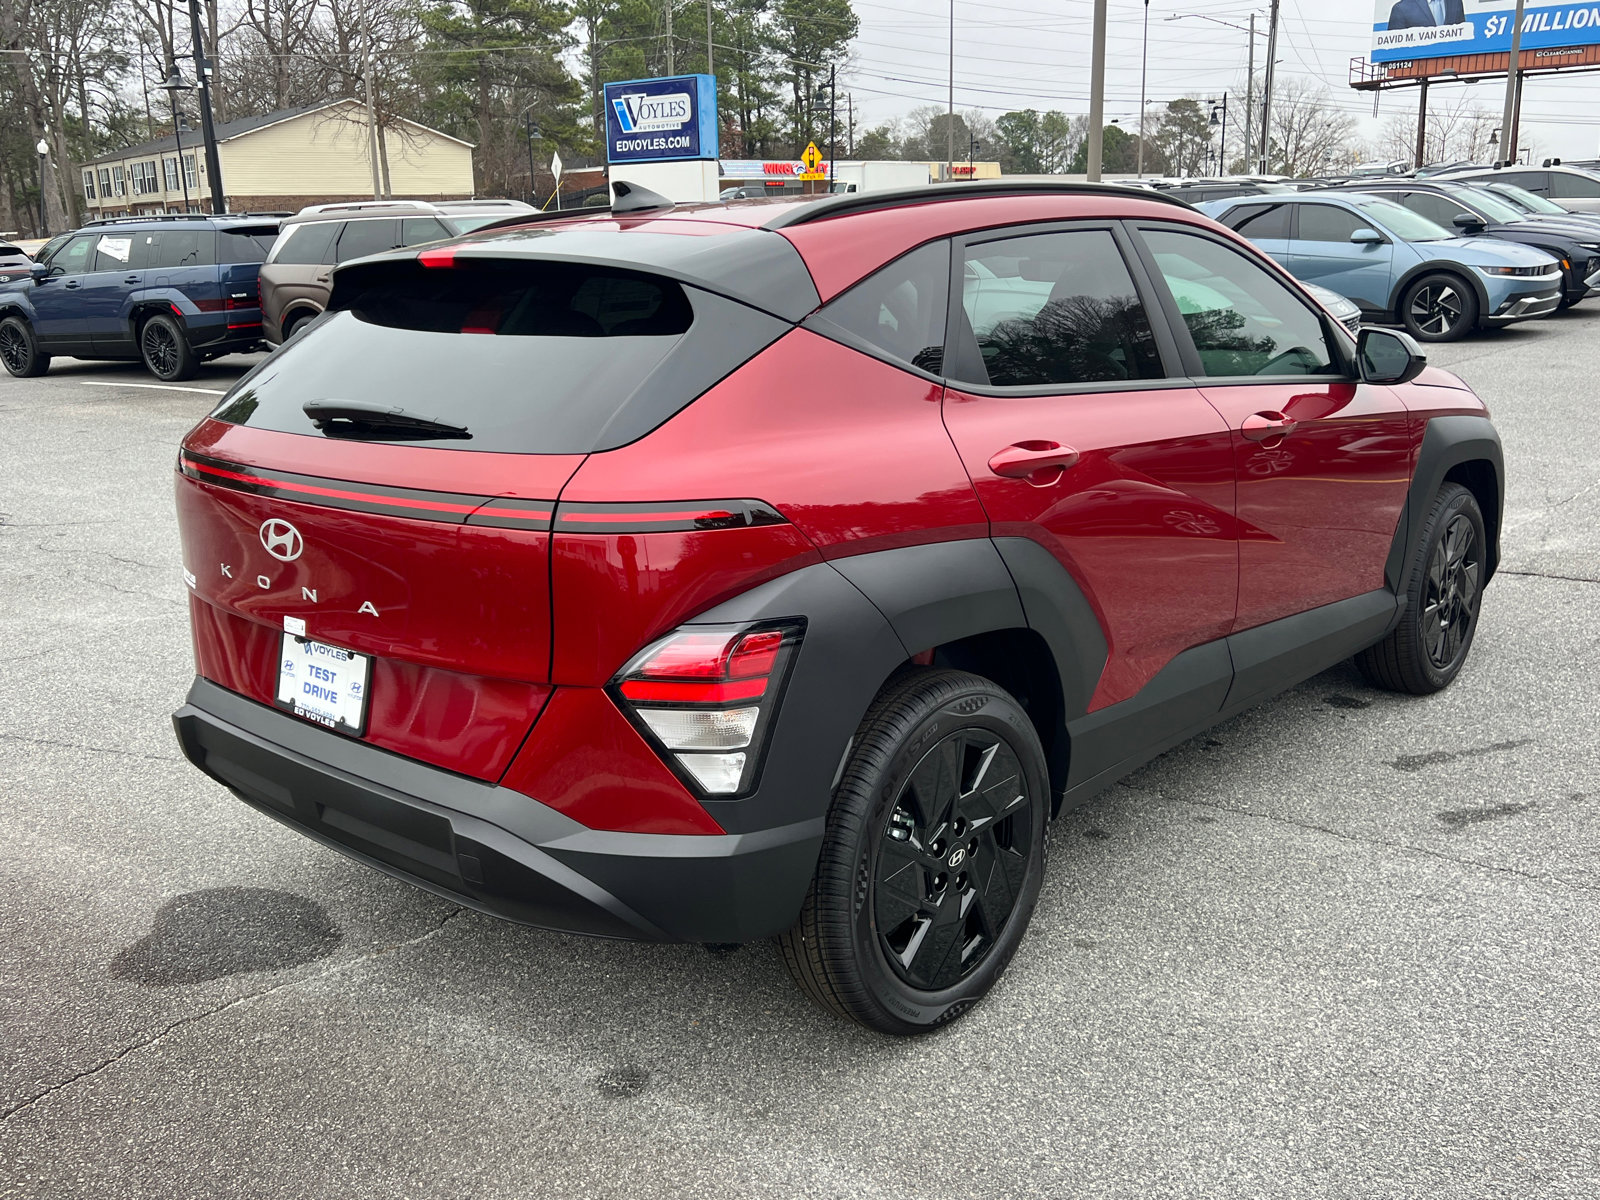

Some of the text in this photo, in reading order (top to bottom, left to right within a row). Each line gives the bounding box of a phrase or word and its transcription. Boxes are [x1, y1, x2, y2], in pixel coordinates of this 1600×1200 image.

[1377, 27, 1464, 45] DAVID M. VAN SANT
[1484, 15, 1507, 39] $1
[1388, 61, 1412, 70] 051124
[638, 122, 680, 130] AUTOMOTIVE
[616, 136, 690, 152] EDVOYLES.COM
[763, 163, 794, 175] WING
[313, 643, 347, 661] VOYLES
[308, 664, 336, 683] TEST
[303, 681, 338, 704] DRIVE
[294, 706, 305, 716] ED
[305, 709, 336, 728] VOYLES
